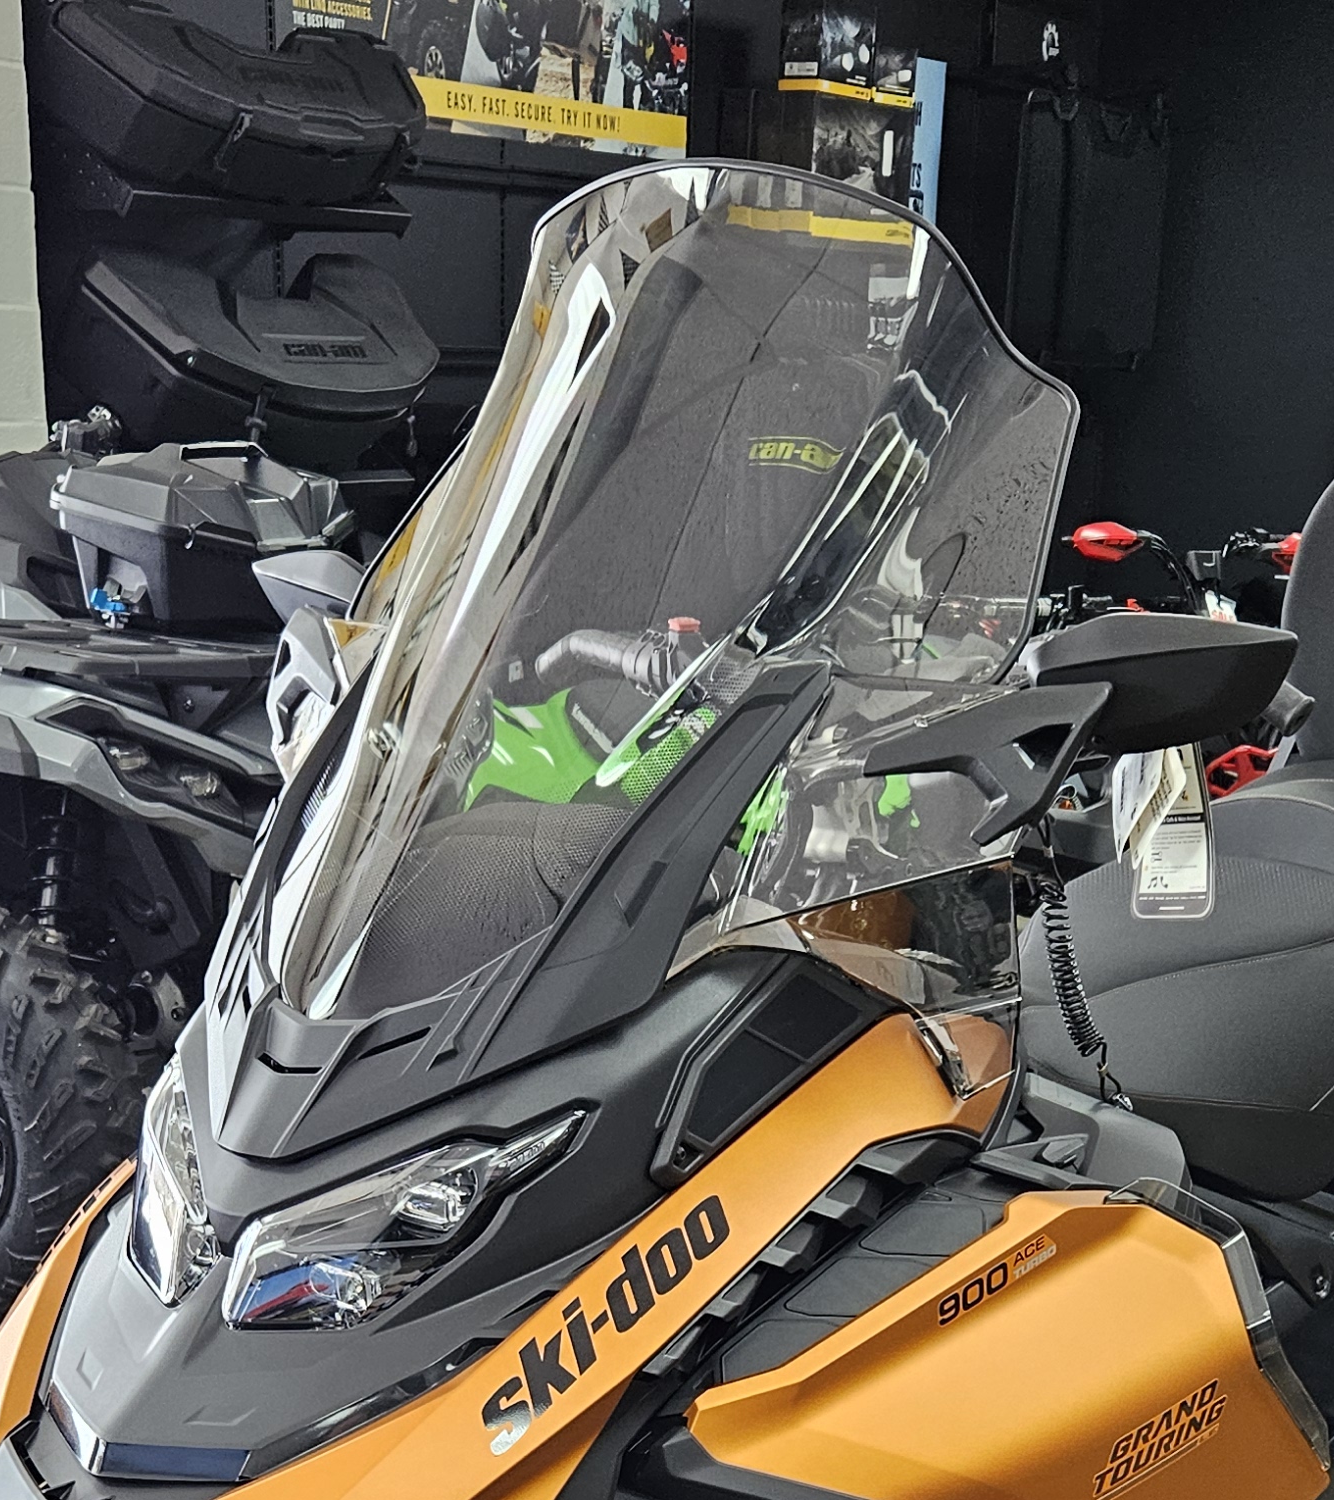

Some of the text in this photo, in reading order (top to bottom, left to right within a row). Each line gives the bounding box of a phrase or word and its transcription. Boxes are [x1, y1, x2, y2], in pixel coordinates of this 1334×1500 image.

[446, 90, 621, 133] EASY. FAST. SECURE. TRY IT NOW!
[938, 1235, 1046, 1327] 900 ACE
[1013, 1244, 1057, 1280] TURBO
[481, 1194, 731, 1457] ski-doo
[1093, 1395, 1227, 1496] TOURING
[1109, 1379, 1219, 1465] GRAND
